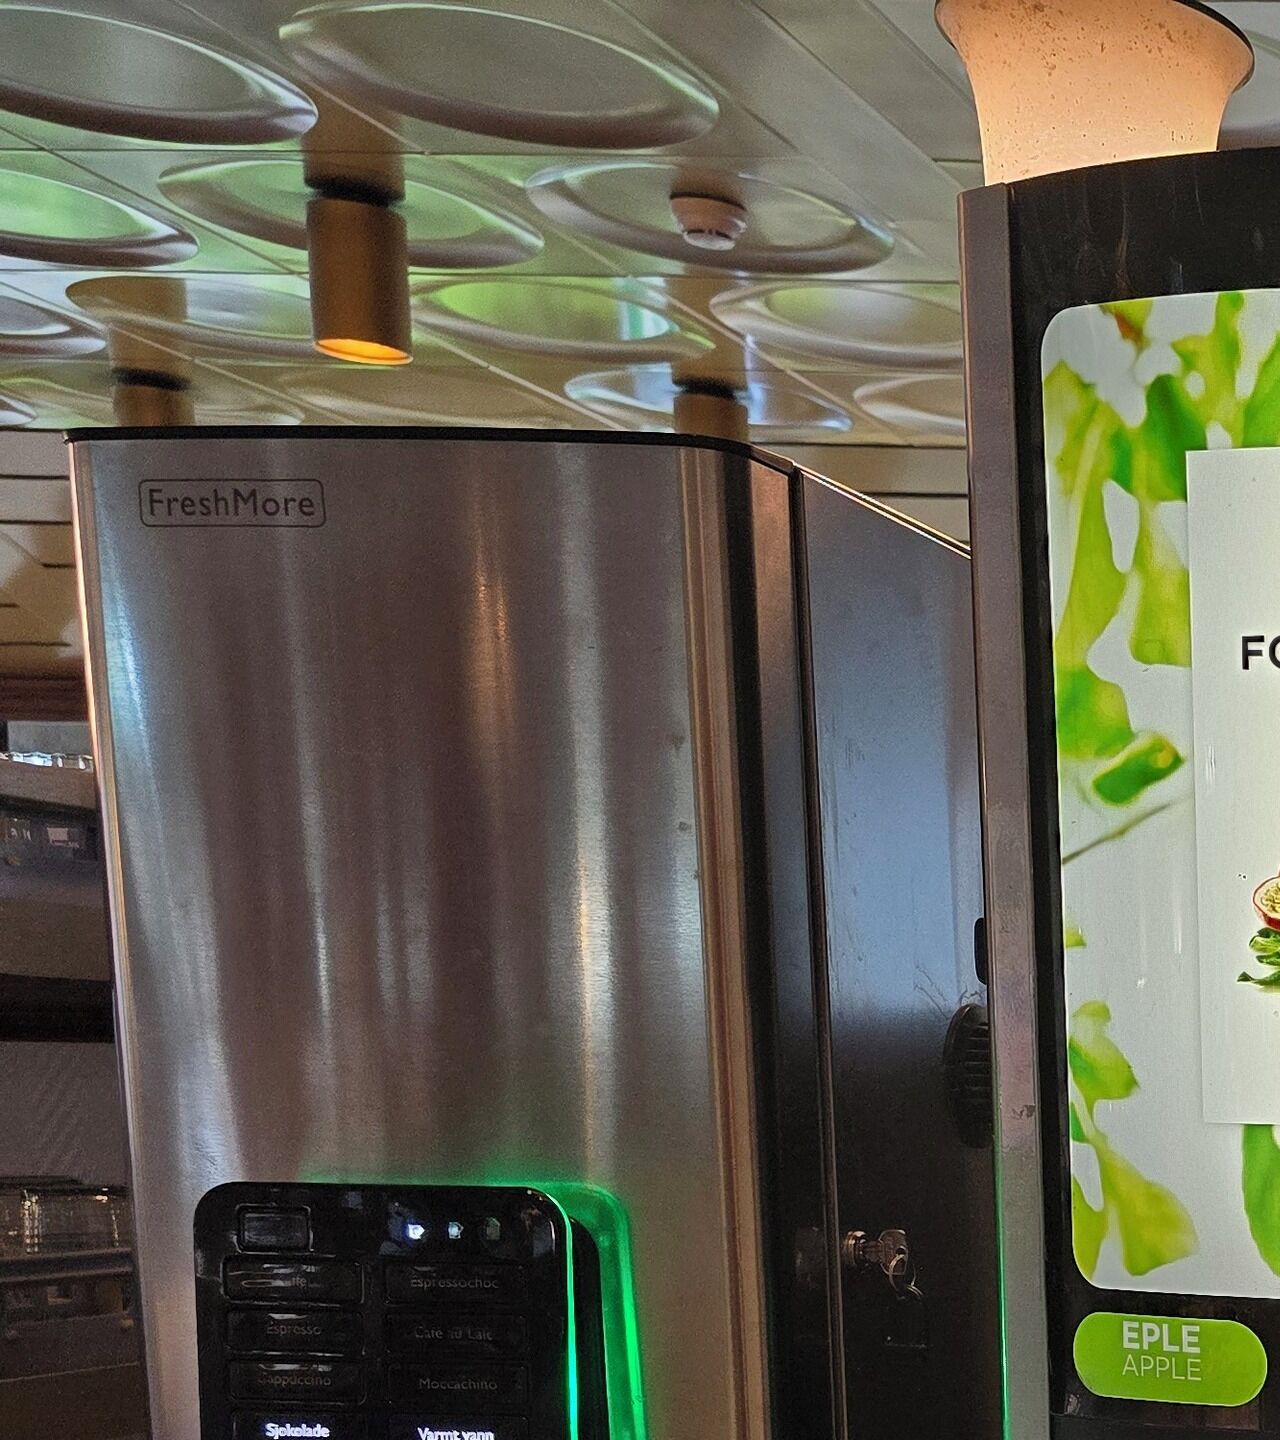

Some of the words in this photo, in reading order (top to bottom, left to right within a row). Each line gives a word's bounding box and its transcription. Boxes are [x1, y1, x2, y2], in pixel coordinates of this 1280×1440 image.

[148, 488, 316, 517] FreshMore
[1121, 1321, 1202, 1354] EPLE
[1121, 1354, 1203, 1382] APPLE
[264, 1423, 331, 1440] Sjokolade
